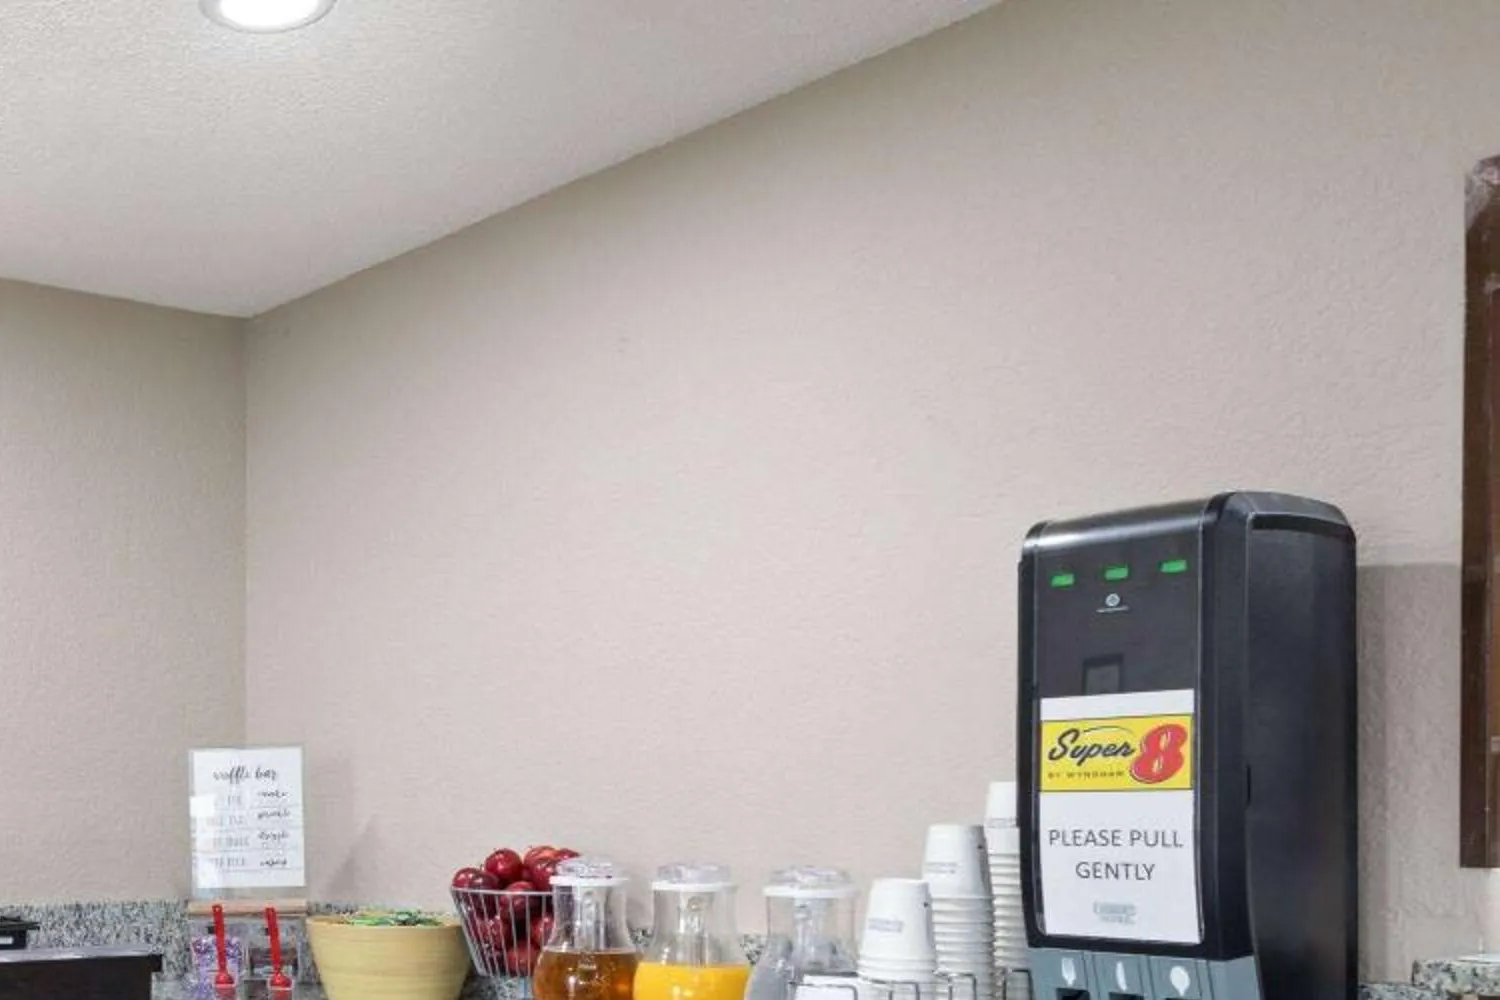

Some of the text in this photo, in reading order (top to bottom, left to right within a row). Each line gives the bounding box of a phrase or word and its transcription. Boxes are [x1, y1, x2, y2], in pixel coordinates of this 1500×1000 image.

[1048, 723, 1188, 784] Super 8
[1048, 829, 1184, 848] PLEASE PULL
[1075, 861, 1156, 881] GENTLY
